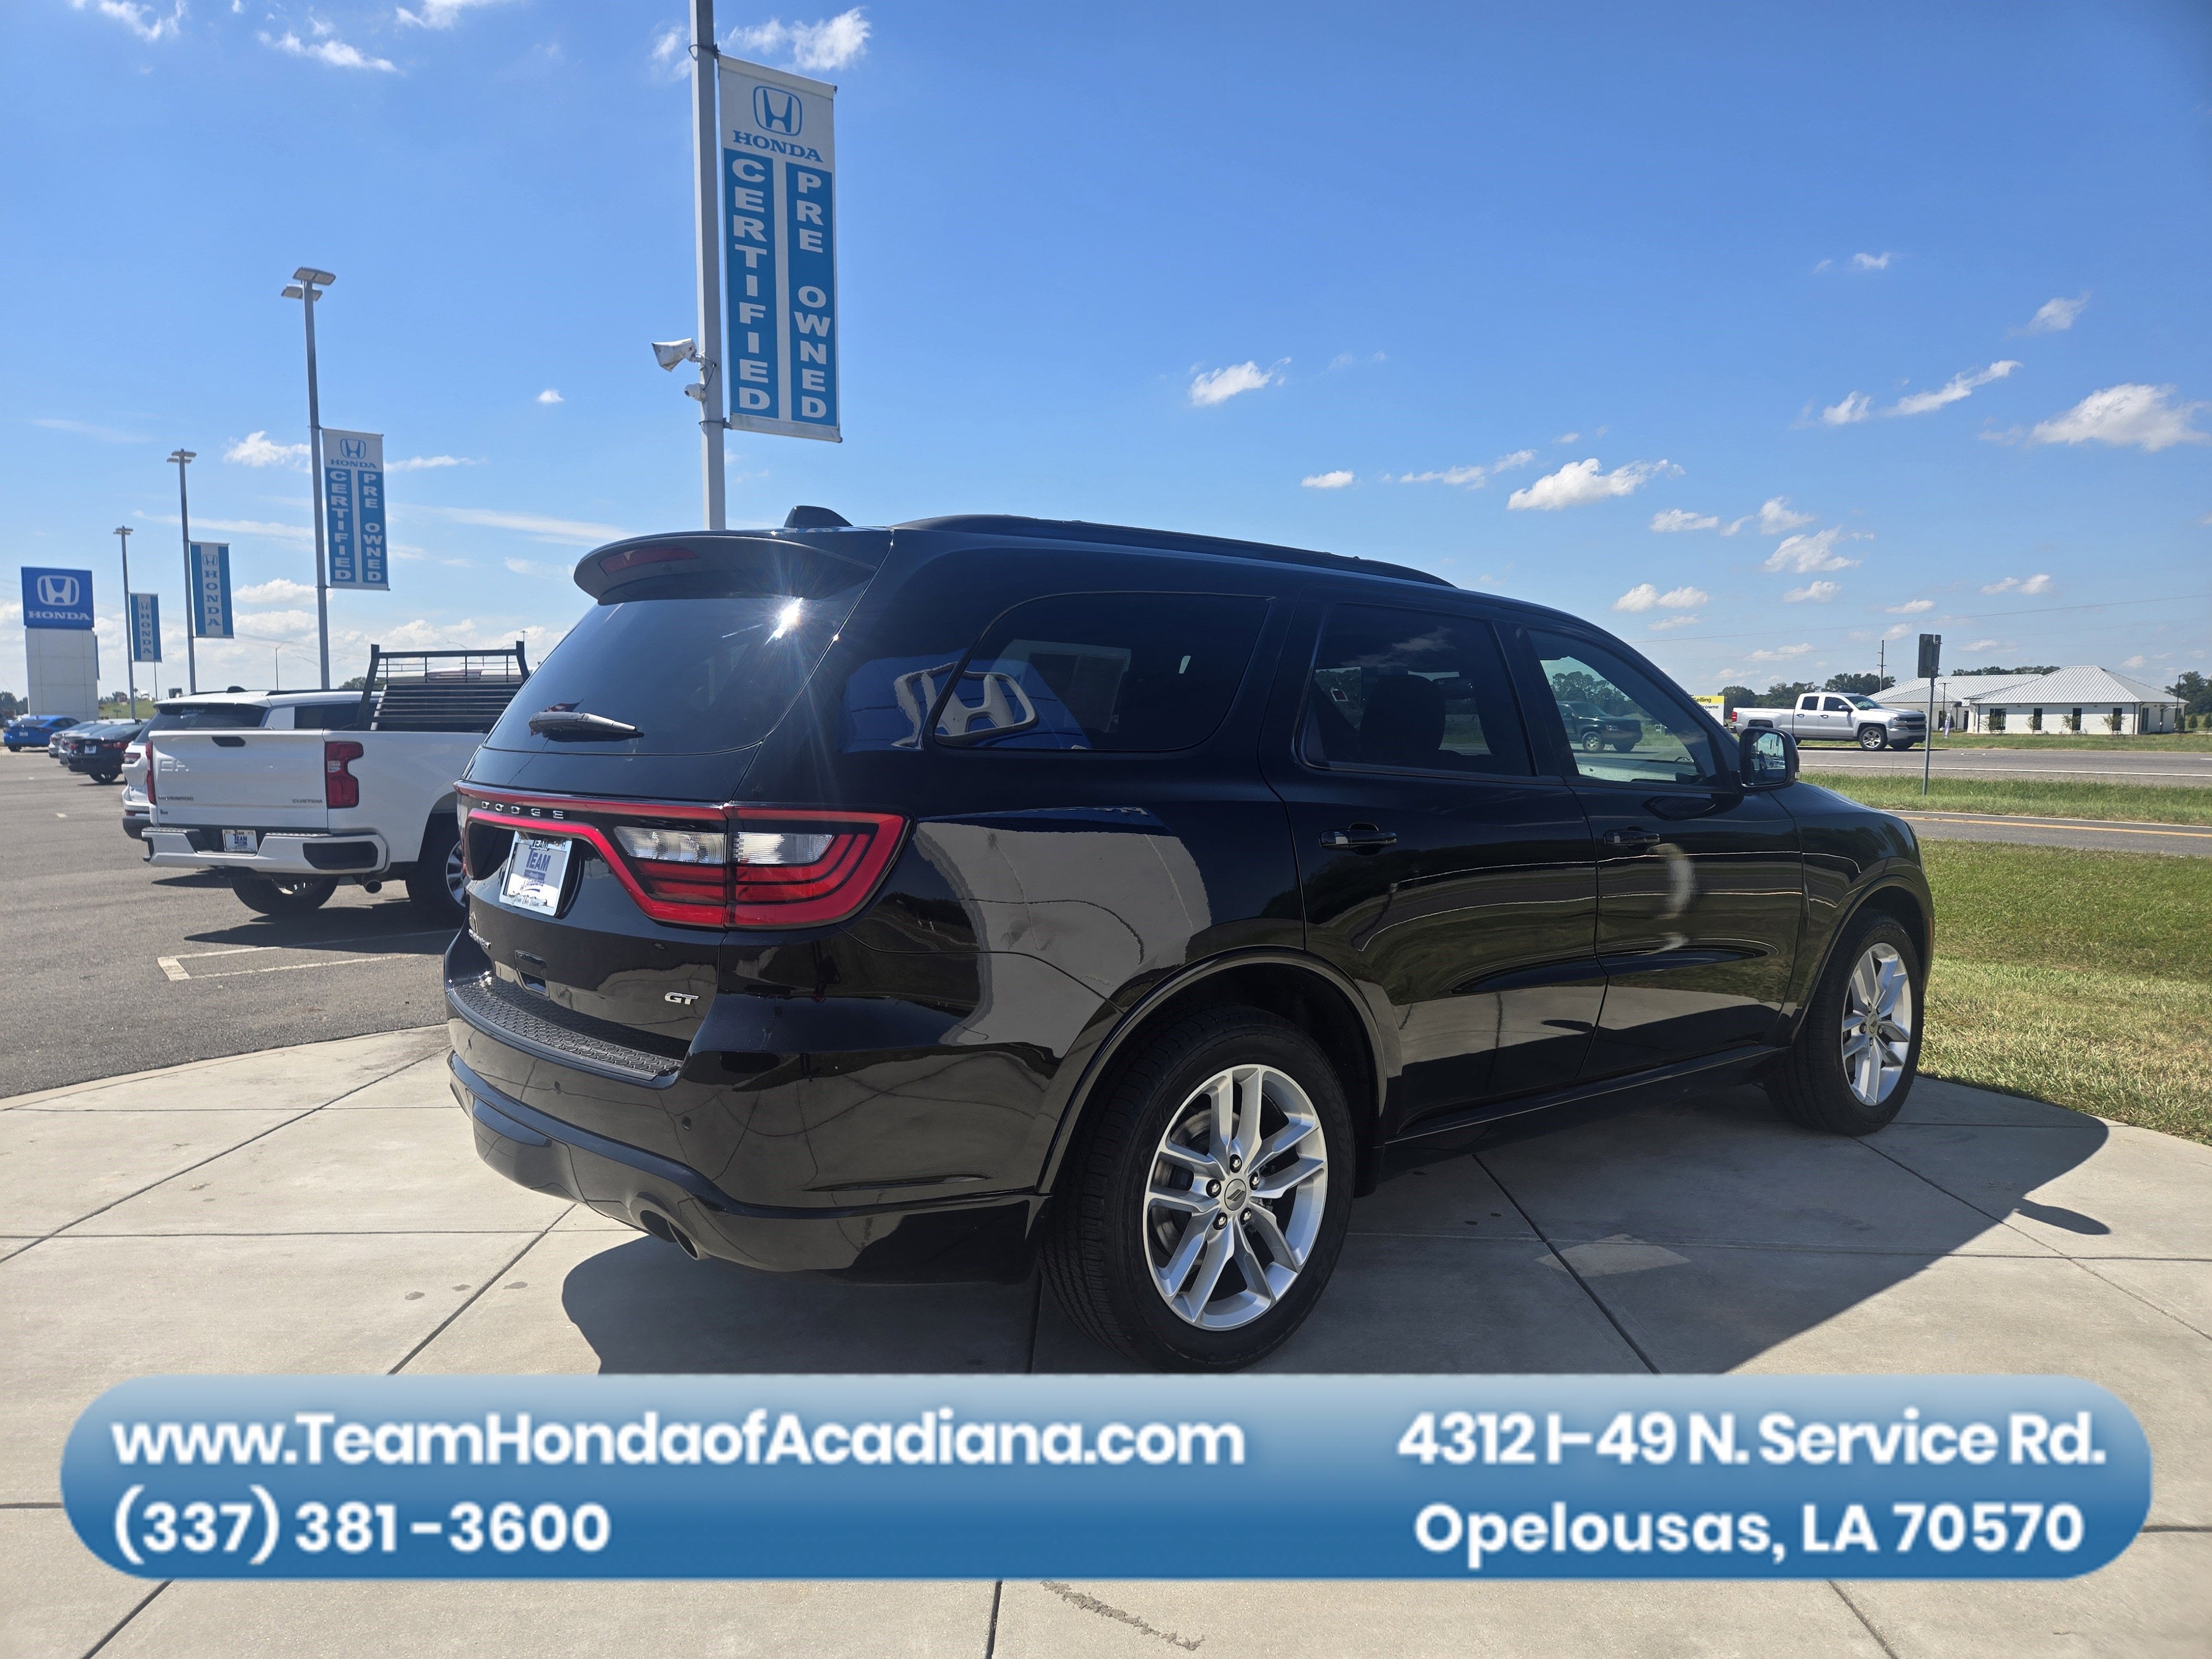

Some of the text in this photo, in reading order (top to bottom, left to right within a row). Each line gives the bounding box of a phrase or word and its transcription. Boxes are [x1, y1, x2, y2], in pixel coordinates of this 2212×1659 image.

[732, 129, 823, 163] HONDA
[732, 158, 770, 410] CERTIFIED
[793, 171, 831, 419] PRE OWNED
[330, 459, 377, 469] HONDA
[330, 471, 352, 580] CERTIFIED
[363, 473, 383, 581] PRE OWNED
[28, 610, 91, 620] HONDA
[204, 570, 221, 627] HONDA
[140, 613, 152, 654] HONDA
[482, 801, 564, 820] DODGE
[526, 846, 551, 872] TEAM
[665, 992, 700, 1005] GT
